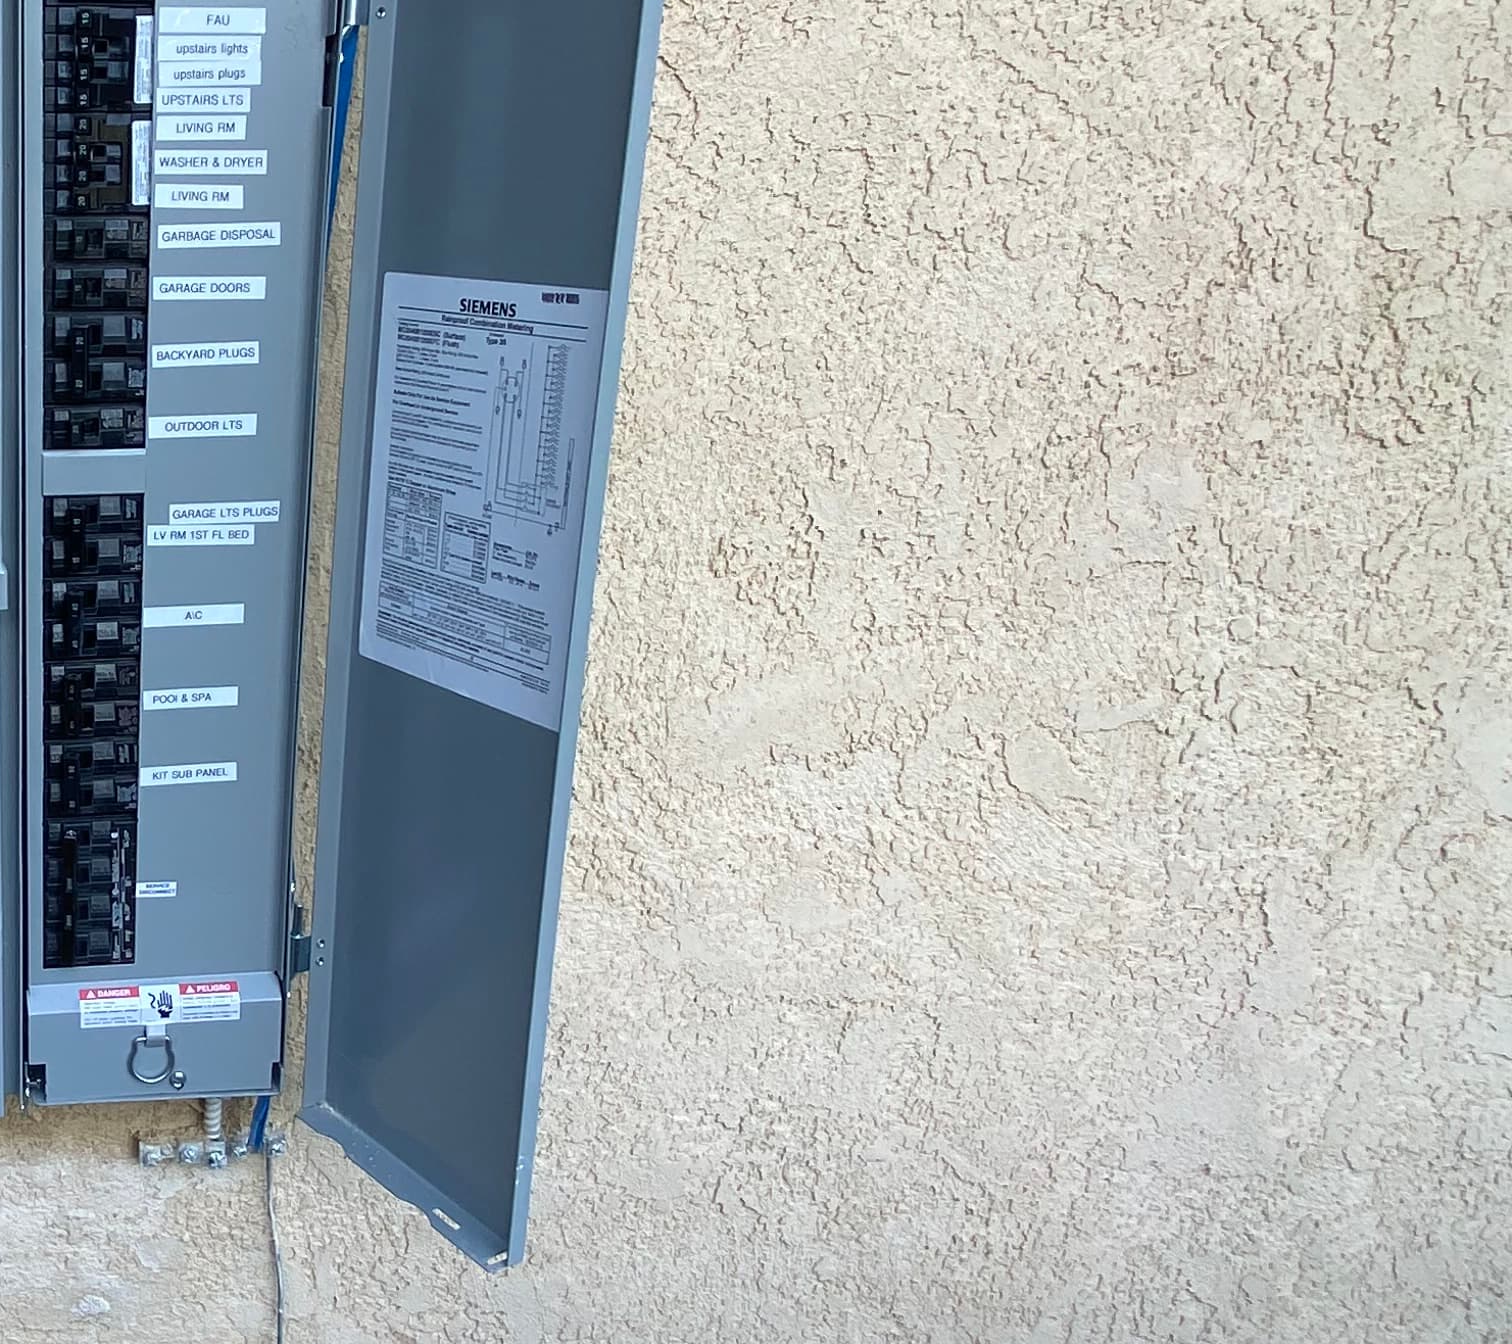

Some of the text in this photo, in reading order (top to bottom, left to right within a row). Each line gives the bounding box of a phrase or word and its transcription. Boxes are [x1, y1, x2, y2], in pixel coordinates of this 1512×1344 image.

[206, 14, 230, 26] FAU
[81, 37, 89, 48] 15
[176, 43, 248, 55] upstairs lights
[80, 68, 88, 80] 15
[173, 68, 246, 80] upstairs plugs
[79, 94, 88, 105] 15
[161, 94, 244, 105] UPSTAIRS LTS
[176, 122, 236, 134] LIVING RM
[79, 144, 86, 155] 20
[159, 157, 263, 168] WASHER & DRYER
[77, 196, 86, 207] 20
[171, 190, 230, 202] LIVING RM
[161, 229, 276, 242] GARBAGE DISPOSAL
[159, 282, 250, 293] GARAGE DOORS
[459, 297, 517, 318] SIEMENS
[156, 347, 256, 361] BACKYARD PLUGS
[164, 419, 243, 432] OUTDOOR LTS
[172, 507, 278, 519] GARAGE LTS PLUGS
[153, 530, 249, 540] LV RM 1ST FL BED
[181, 693, 188, 703] &
[191, 692, 212, 702] SPA
[152, 767, 228, 780] KIT SUB PANEL
[97, 989, 131, 997] DANGER
[196, 983, 231, 992] PELIGRO
